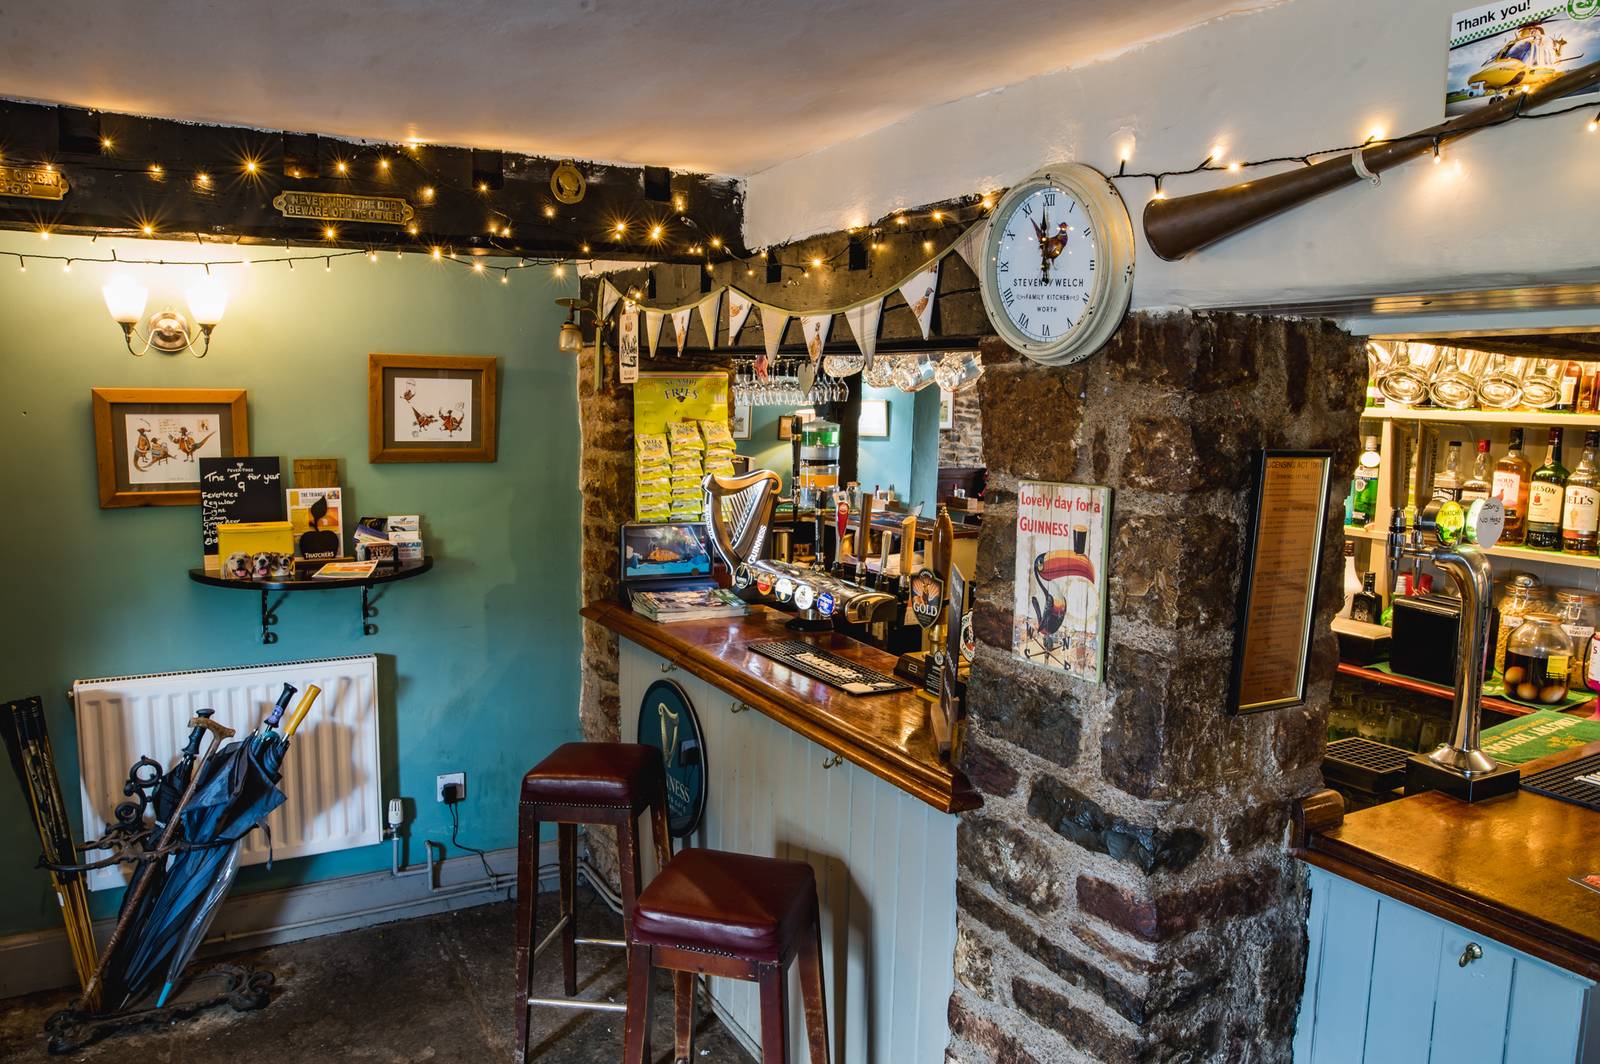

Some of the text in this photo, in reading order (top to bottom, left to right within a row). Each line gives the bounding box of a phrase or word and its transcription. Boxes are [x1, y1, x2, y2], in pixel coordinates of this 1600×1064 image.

[1457, 0, 1531, 33] Thank you!
[291, 195, 325, 206] NEVER
[328, 197, 351, 208] MIND
[377, 200, 399, 211] DOG
[1043, 193, 1056, 207] XII
[288, 205, 402, 221] BEWARE OF THE OWNER
[664, 387, 700, 401] FRIES
[230, 472, 241, 481] T
[247, 473, 261, 481] for
[203, 499, 236, 509] Regular
[1021, 492, 1101, 514] Lovely day for a
[1019, 516, 1069, 538] GUINNESS
[747, 524, 767, 565] GUINNESS
[305, 551, 335, 560] THATCHERS
[912, 601, 938, 617] GOLD
